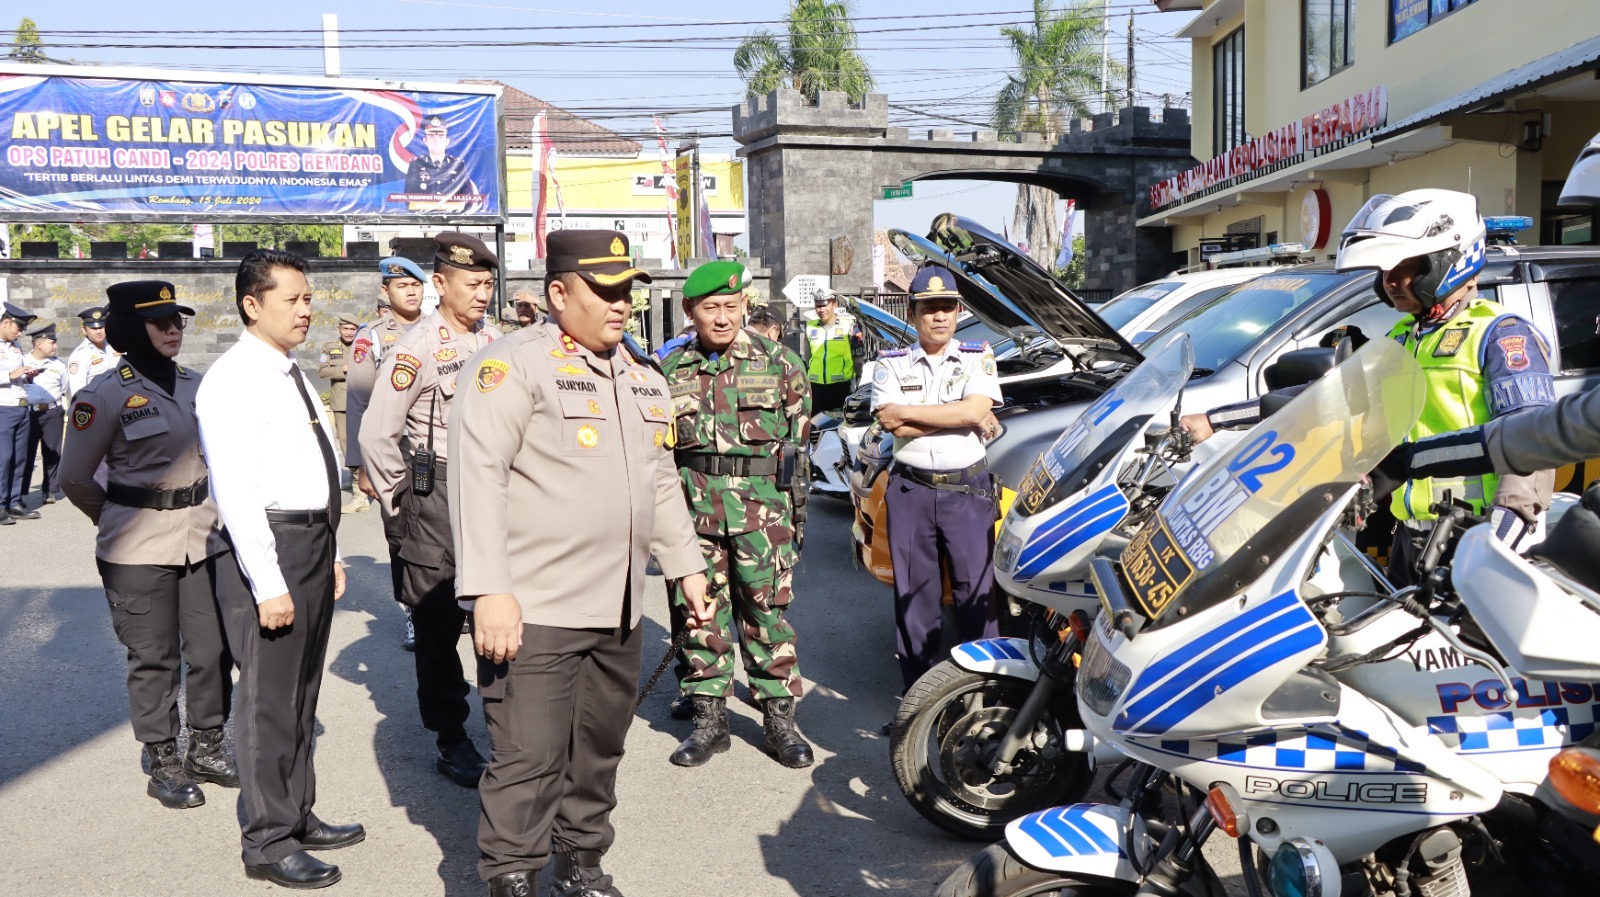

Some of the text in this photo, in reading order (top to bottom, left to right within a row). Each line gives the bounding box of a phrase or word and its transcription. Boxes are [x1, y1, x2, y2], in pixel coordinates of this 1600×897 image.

[11, 112, 377, 148] APEL GELAR PASUKAN
[1229, 121, 1297, 177] KEPOLISIAN
[1302, 85, 1381, 151] TERPADU
[8, 145, 48, 167] OPS
[51, 147, 111, 168] PATUH
[114, 148, 170, 169] CANDI
[187, 150, 232, 170] 2024
[234, 151, 300, 172] POLRES
[302, 153, 384, 173] REMBANG
[72, 173, 122, 183] BERLALU
[126, 174, 163, 184] LINTAS
[165, 175, 193, 184] DEMI
[196, 176, 278, 186] TERWUJUDNYA
[280, 177, 337, 187] INDONESIA
[148, 195, 262, 207] Rembang, 15 Juli 2024
[436, 360, 465, 376] ROHMA
[556, 380, 597, 393] SURYADI
[631, 386, 663, 397] POLRI
[121, 407, 160, 424] ENDAH.S
[1228, 430, 1296, 494] 02
[1183, 466, 1250, 538] BM
[1160, 546, 1176, 564] IX
[1187, 536, 1215, 570] RBG
[1436, 677, 1600, 713] POLIS
[1245, 775, 1428, 803] POLICE
